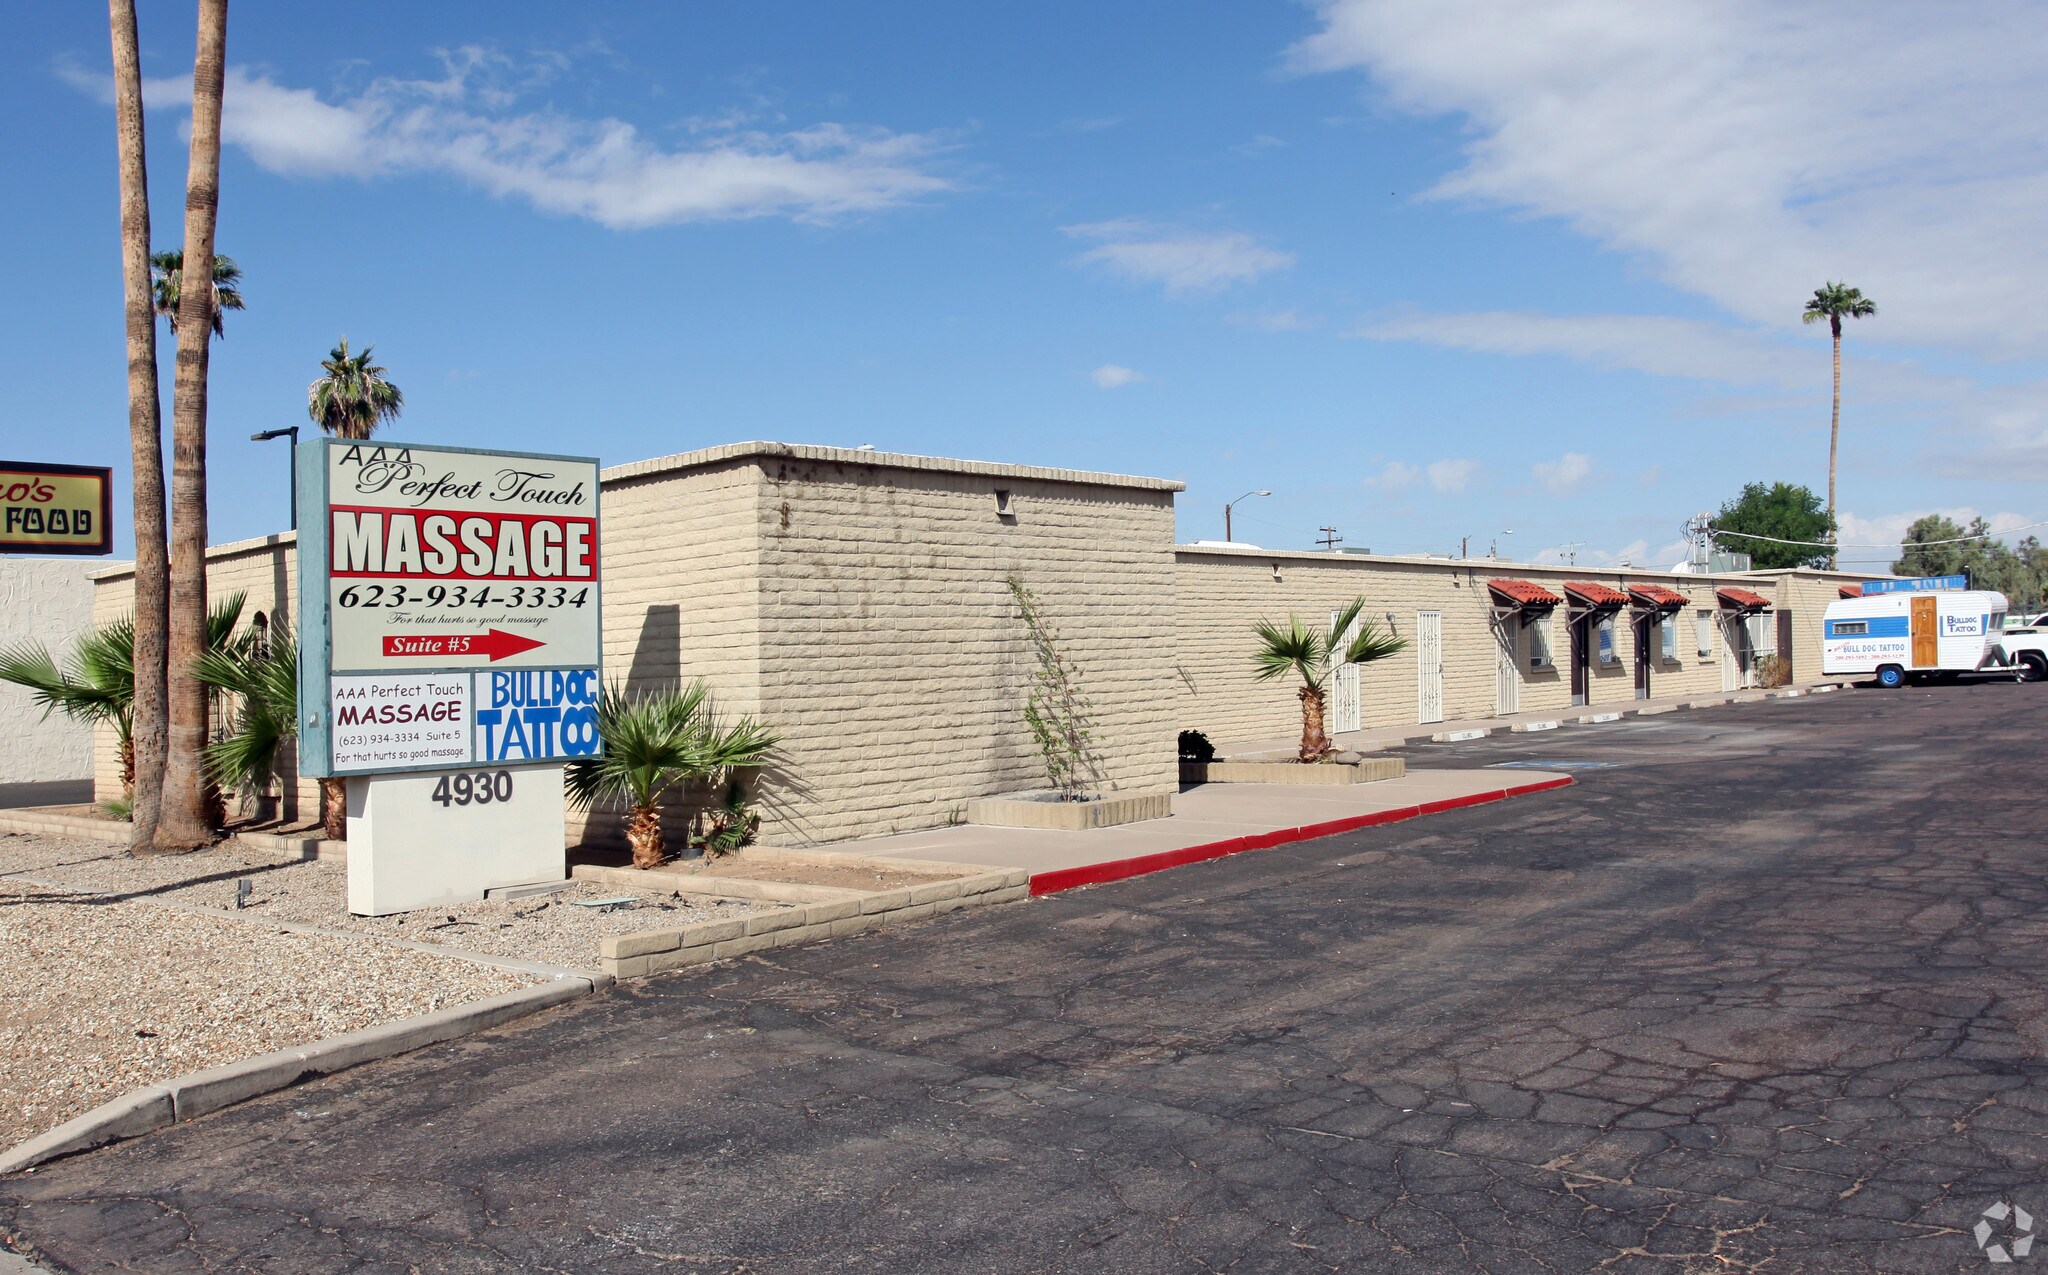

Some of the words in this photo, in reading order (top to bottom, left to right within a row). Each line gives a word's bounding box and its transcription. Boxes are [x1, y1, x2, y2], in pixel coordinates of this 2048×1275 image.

[338, 445, 413, 470] AAA
[355, 460, 482, 507] Perfect
[489, 468, 587, 506] Touch
[6, 506, 92, 535] FOOD
[332, 510, 592, 578] MASSAGE
[338, 584, 589, 609] 623-934-3334
[387, 610, 413, 625] For
[415, 614, 437, 625] that
[438, 614, 464, 625] hurts
[466, 616, 476, 624] so
[476, 614, 506, 628] good
[507, 616, 548, 628] massage
[1946, 615, 1978, 625] BULLDOG
[390, 637, 442, 654] Suite
[448, 636, 471, 653] #5
[1879, 643, 1905, 652] TATTOO
[336, 687, 367, 700] AAA
[371, 683, 422, 698] Perfect
[426, 682, 464, 696] Touch
[492, 669, 598, 709] BULLDOG
[337, 700, 462, 727] MASSAGE
[338, 735, 367, 748] (623)
[370, 732, 420, 745] 934-3334
[426, 731, 452, 742] Suite
[454, 729, 461, 740] 5
[477, 705, 600, 761] TATTOO
[335, 752, 351, 763] For
[353, 752, 371, 762] that
[374, 750, 397, 761] hurts
[399, 751, 408, 760] so
[410, 748, 429, 762] good
[431, 747, 464, 759] massage
[431, 770, 514, 808] 4930
